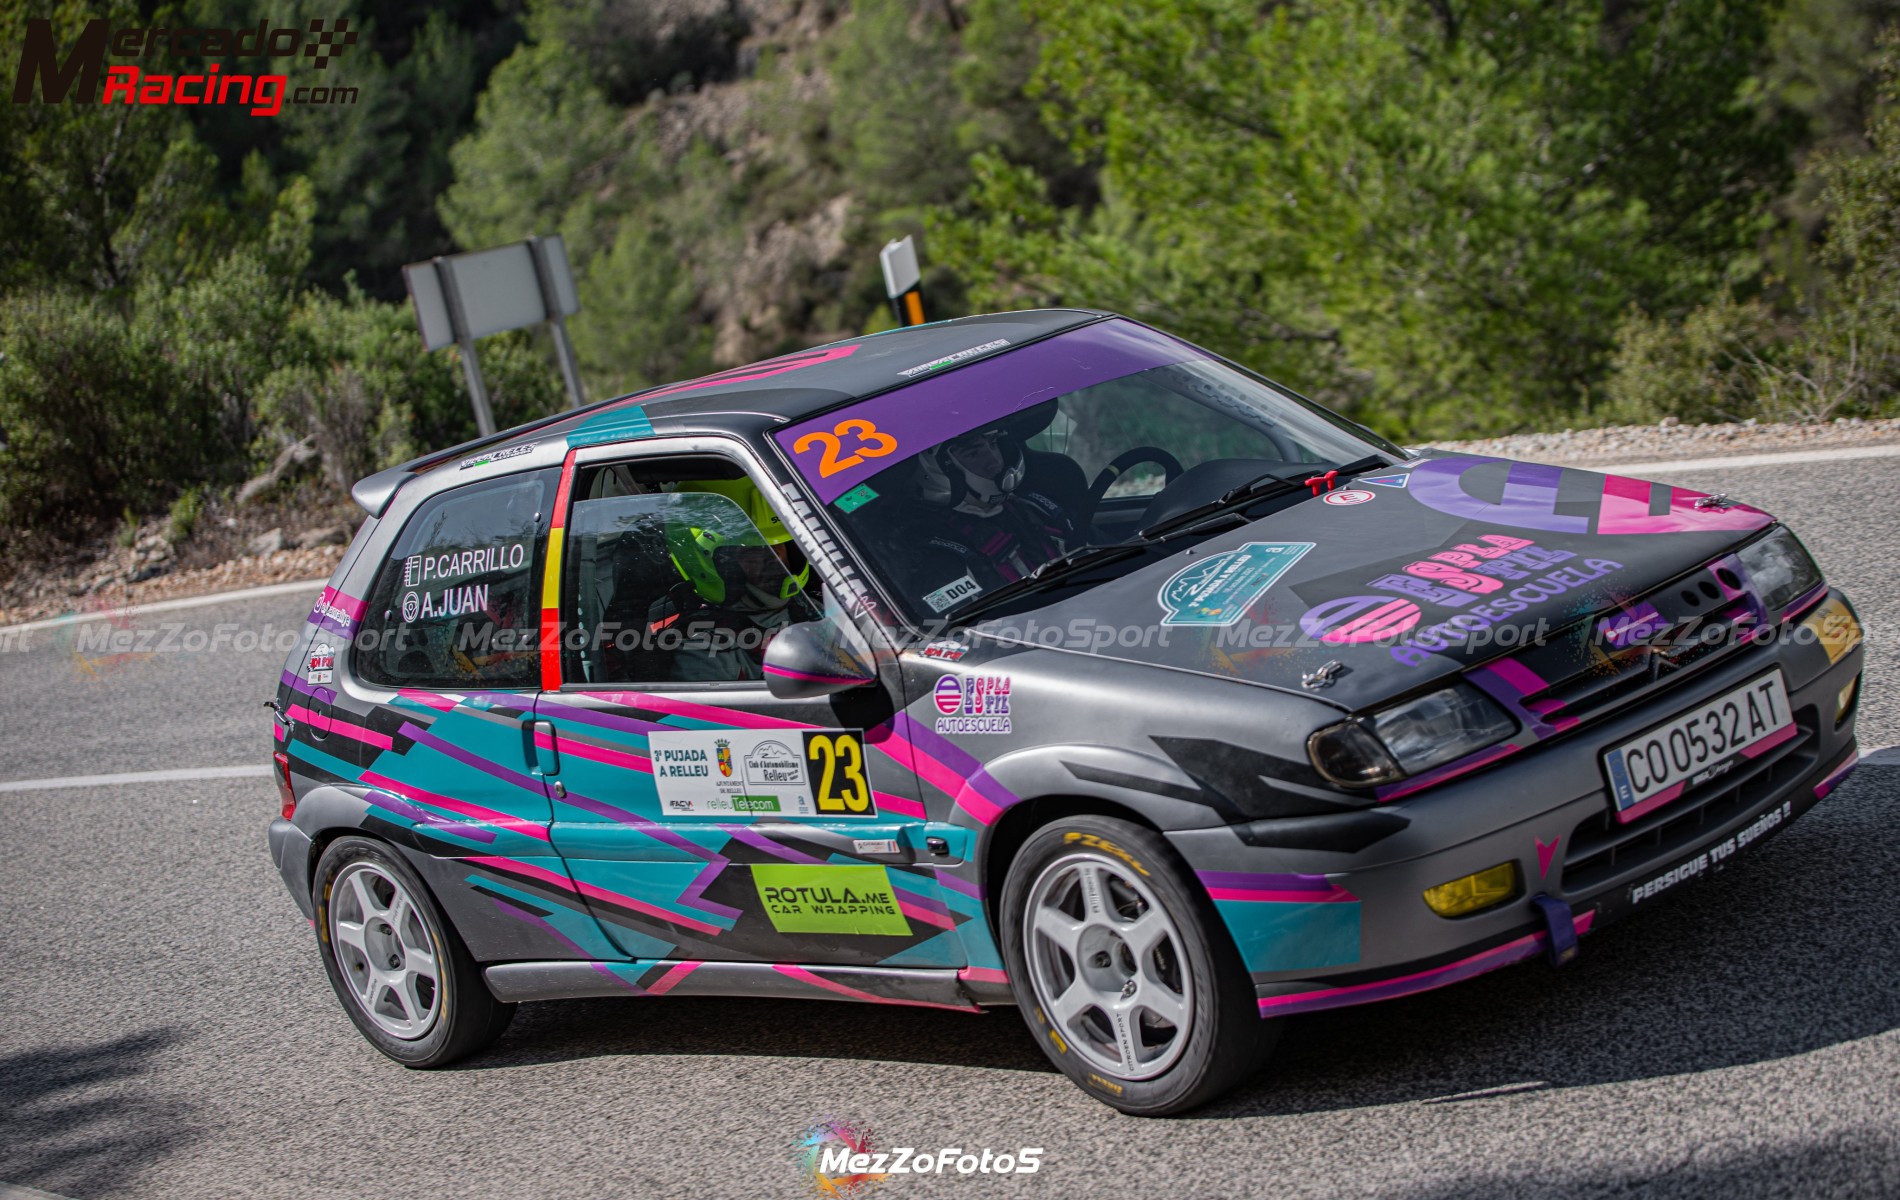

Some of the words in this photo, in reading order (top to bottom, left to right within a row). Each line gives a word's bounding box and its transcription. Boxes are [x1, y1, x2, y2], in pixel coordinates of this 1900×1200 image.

[793, 418, 898, 479] 23
[424, 544, 524, 581] P.CARRILLO
[420, 584, 489, 619] A.JUAN
[1391, 558, 1624, 667] AUTOESCUELA
[936, 718, 1011, 733] AUTOESCUELA
[664, 750, 708, 762] PUJADA
[660, 766, 668, 777] A
[669, 765, 708, 777] RELLEU
[764, 769, 787, 781] Relleu
[809, 734, 869, 812] 23
[1632, 854, 1708, 904] PERSIGUE
[1710, 838, 1737, 864] TUS
[1738, 814, 1783, 848] SUEÑOS
[764, 887, 890, 904] ROTULA.ME
[771, 905, 802, 914] CAR
[813, 905, 896, 915] WRAPPING
